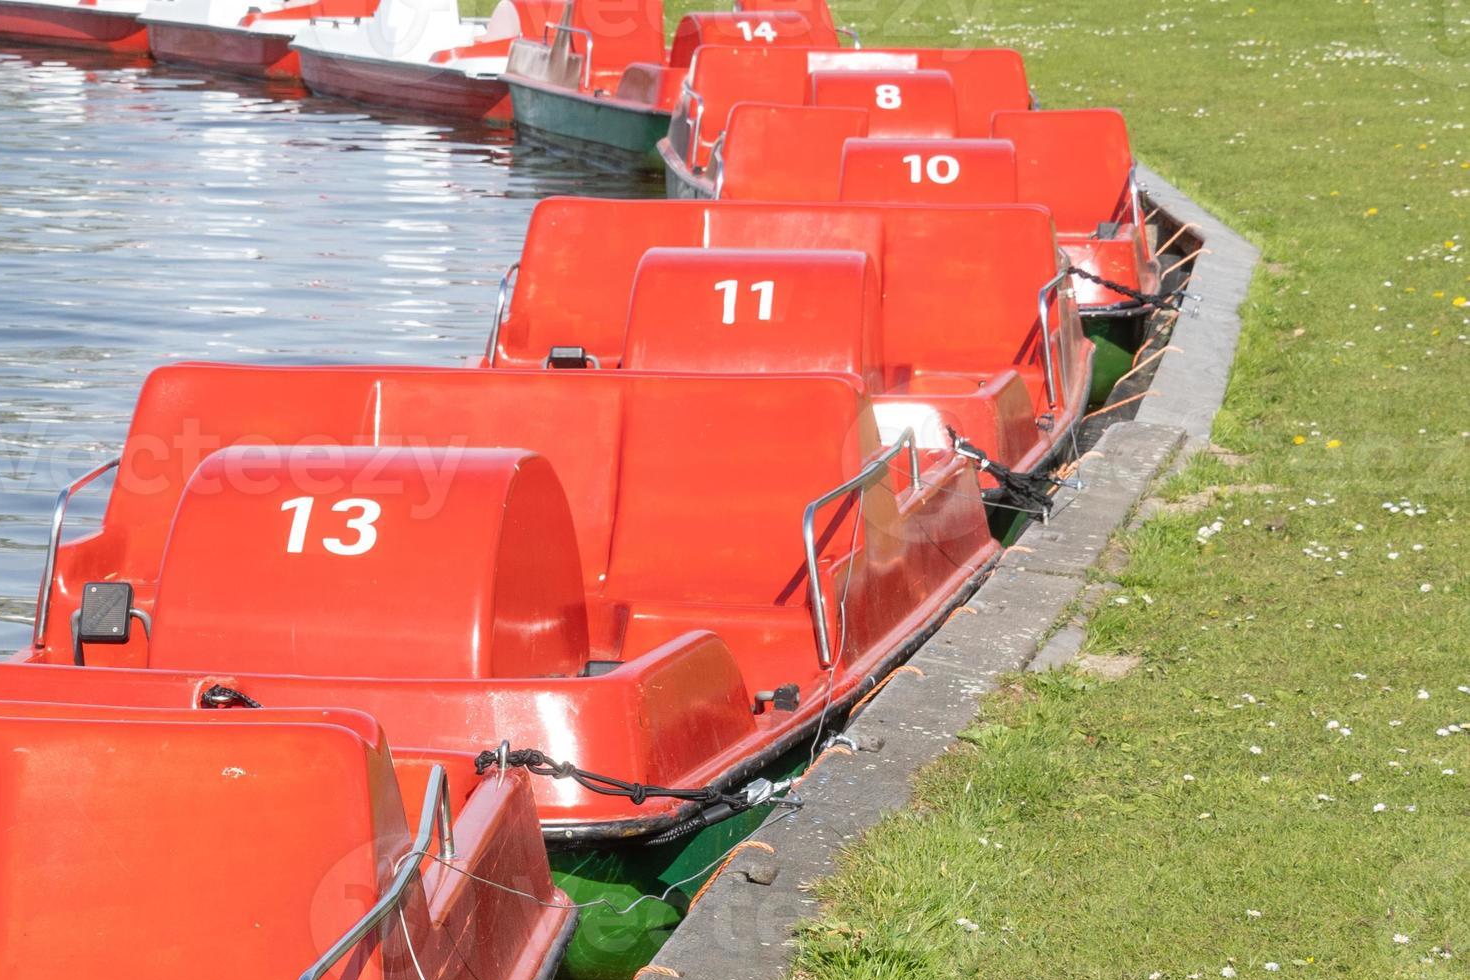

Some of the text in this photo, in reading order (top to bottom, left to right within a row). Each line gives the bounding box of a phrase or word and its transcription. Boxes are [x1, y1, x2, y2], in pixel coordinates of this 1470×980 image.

[736, 21, 777, 42] 14
[875, 84, 902, 110] 8
[902, 154, 960, 184] 10
[714, 279, 775, 325] 11
[280, 496, 382, 556] 13
